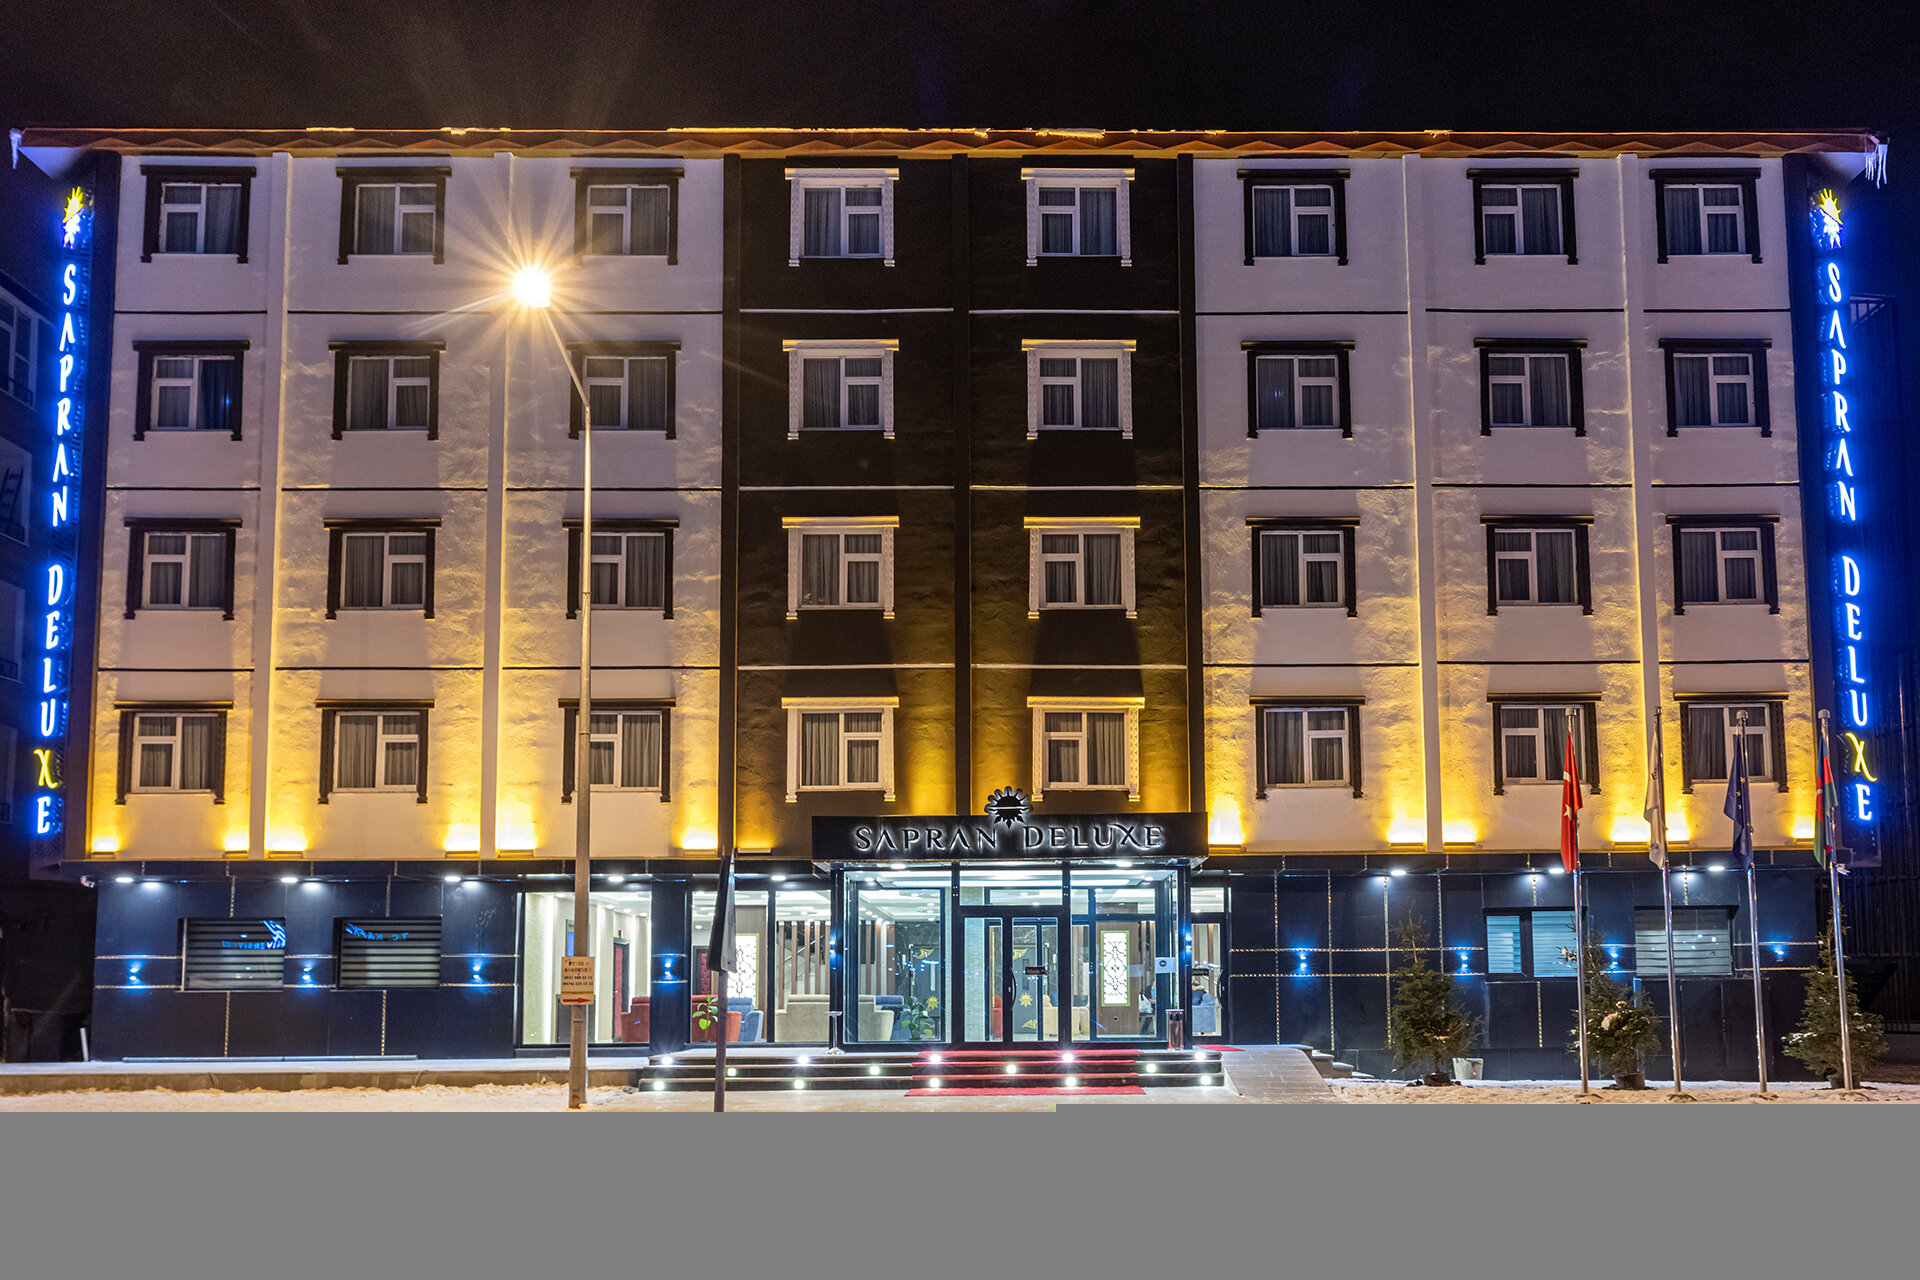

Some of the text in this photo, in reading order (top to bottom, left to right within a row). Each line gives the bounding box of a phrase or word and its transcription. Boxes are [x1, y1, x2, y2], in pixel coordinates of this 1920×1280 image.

[33, 263, 76, 834] SAPRAN DELUXE
[1828, 262, 1877, 821] SAPRAN DELUXE
[855, 823, 1164, 851] SAPRAN DELUXE
